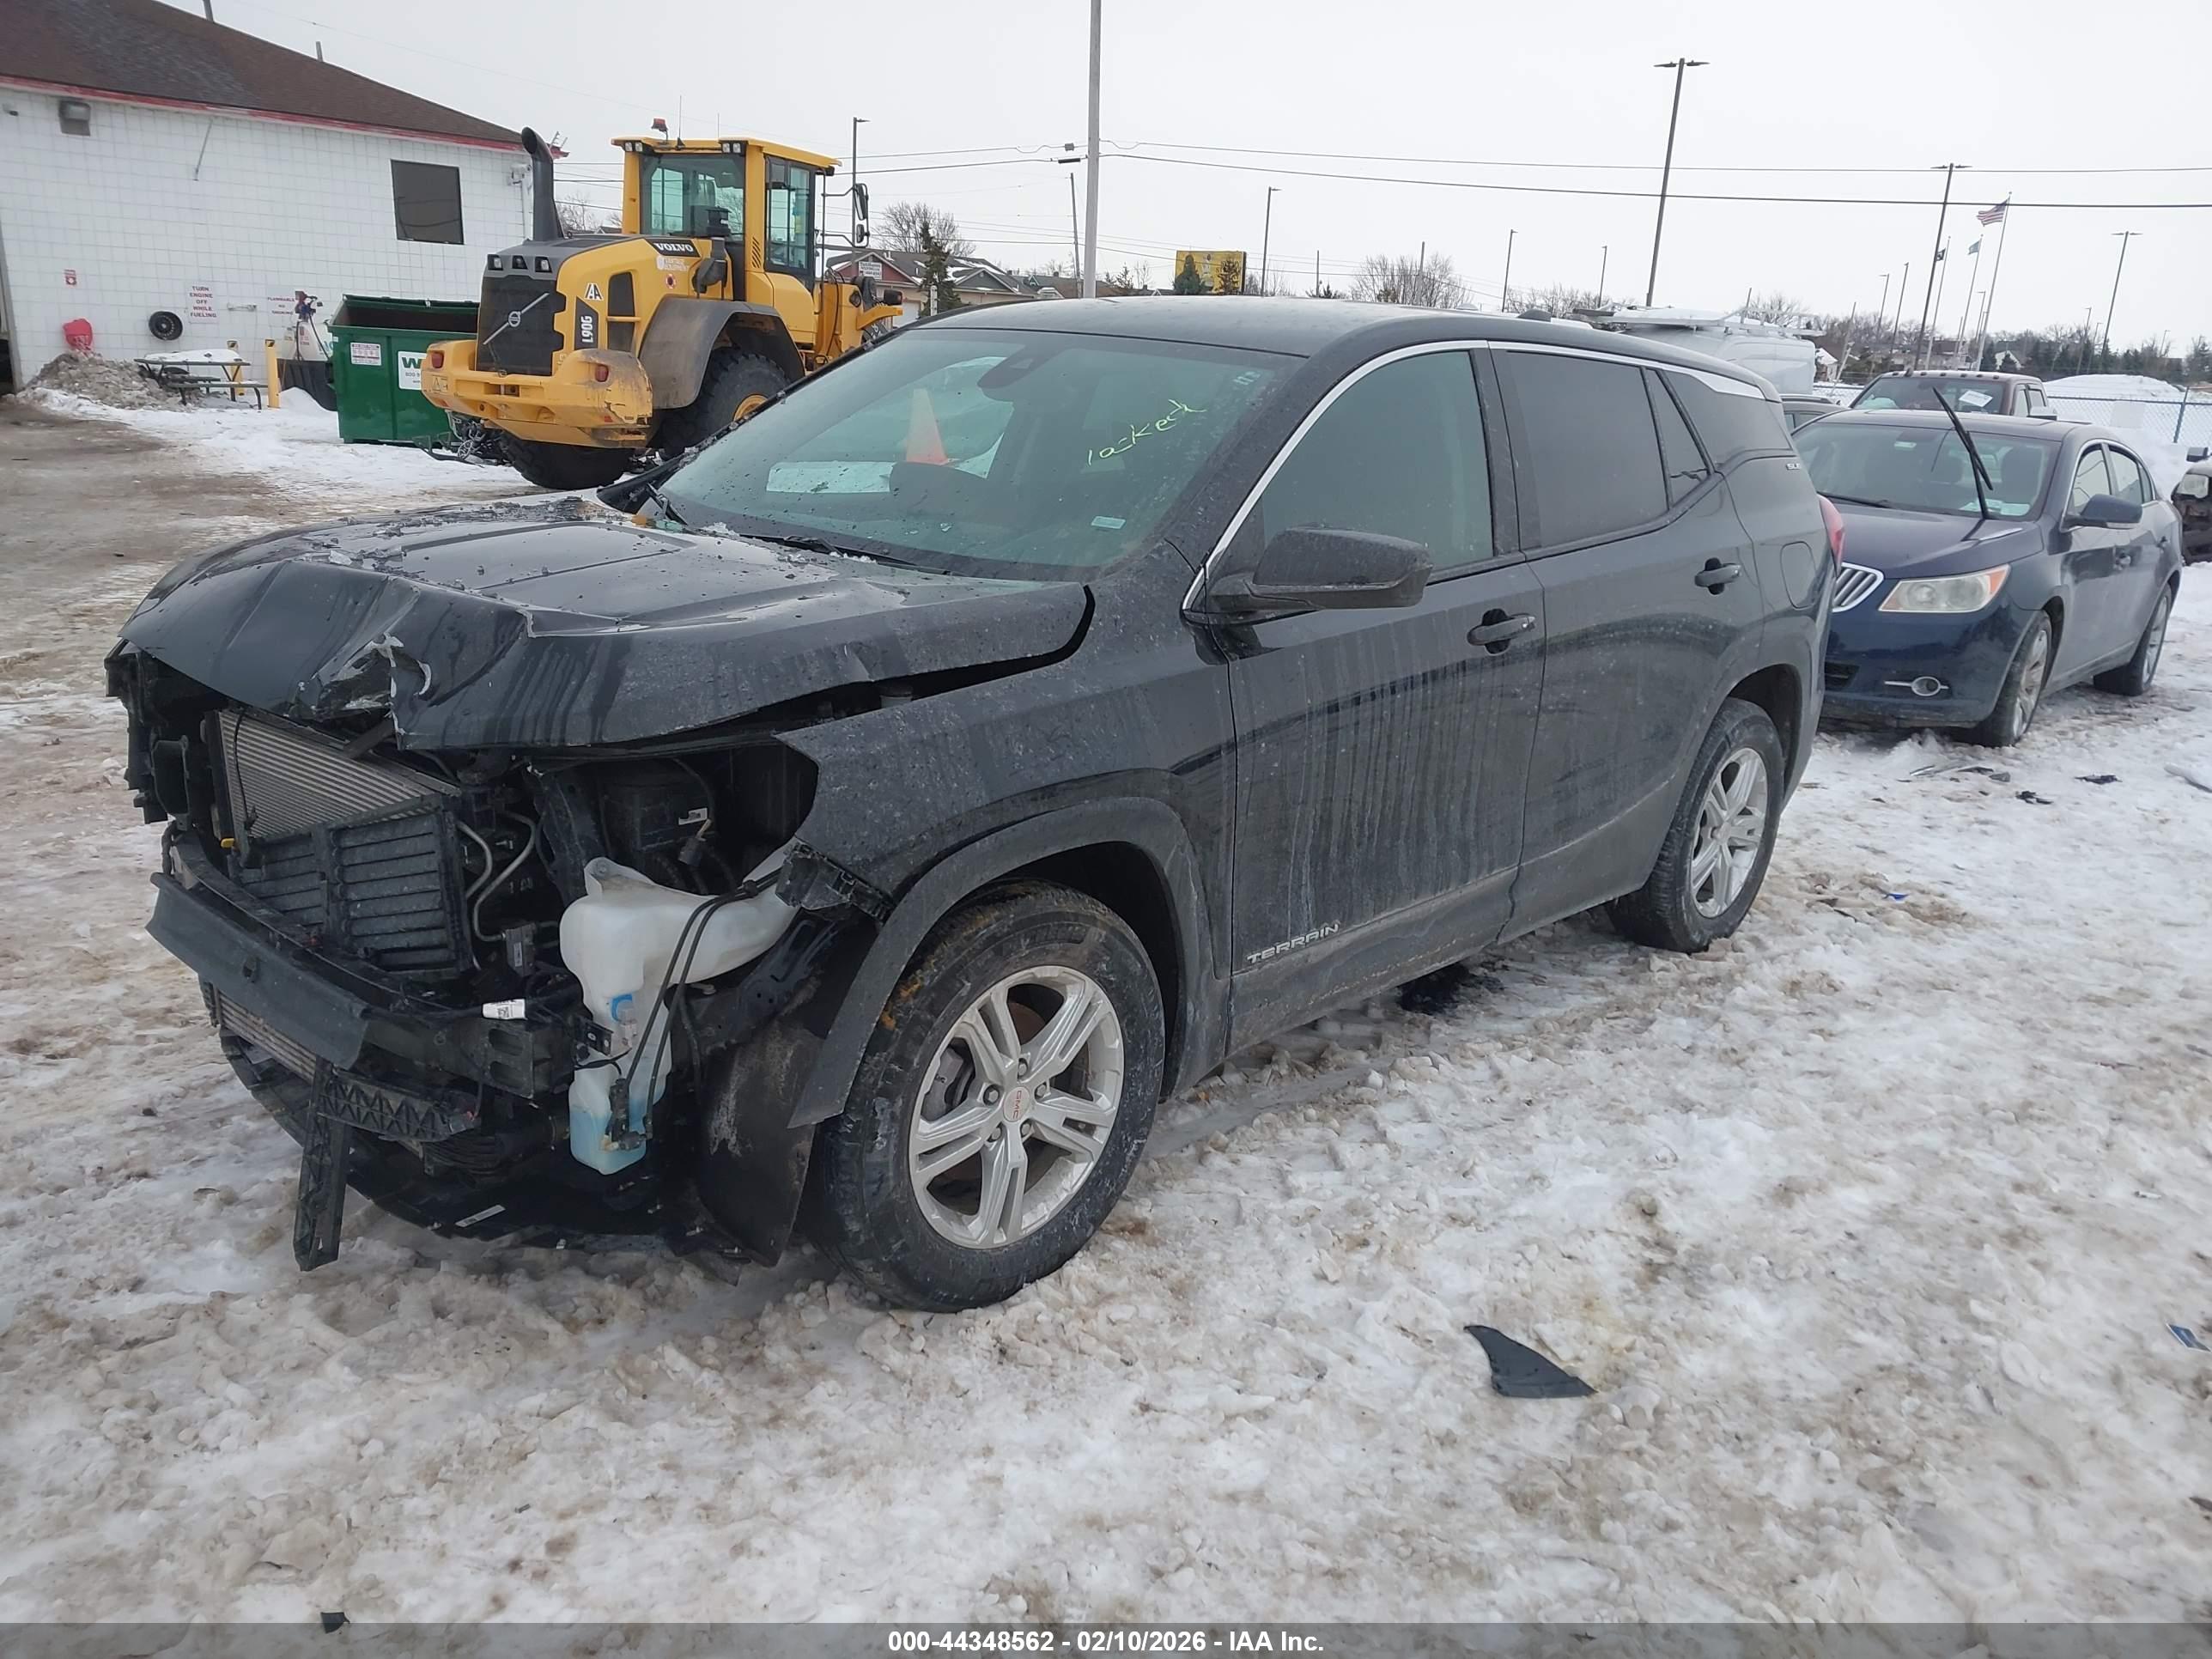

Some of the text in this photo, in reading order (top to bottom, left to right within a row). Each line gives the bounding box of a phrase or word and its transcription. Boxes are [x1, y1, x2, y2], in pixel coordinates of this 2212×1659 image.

[653, 242, 694, 252] VOLVO
[580, 315, 593, 343] L90G
[1247, 922, 1340, 963] TERRAIN
[1012, 1090, 1022, 1119] GMC
